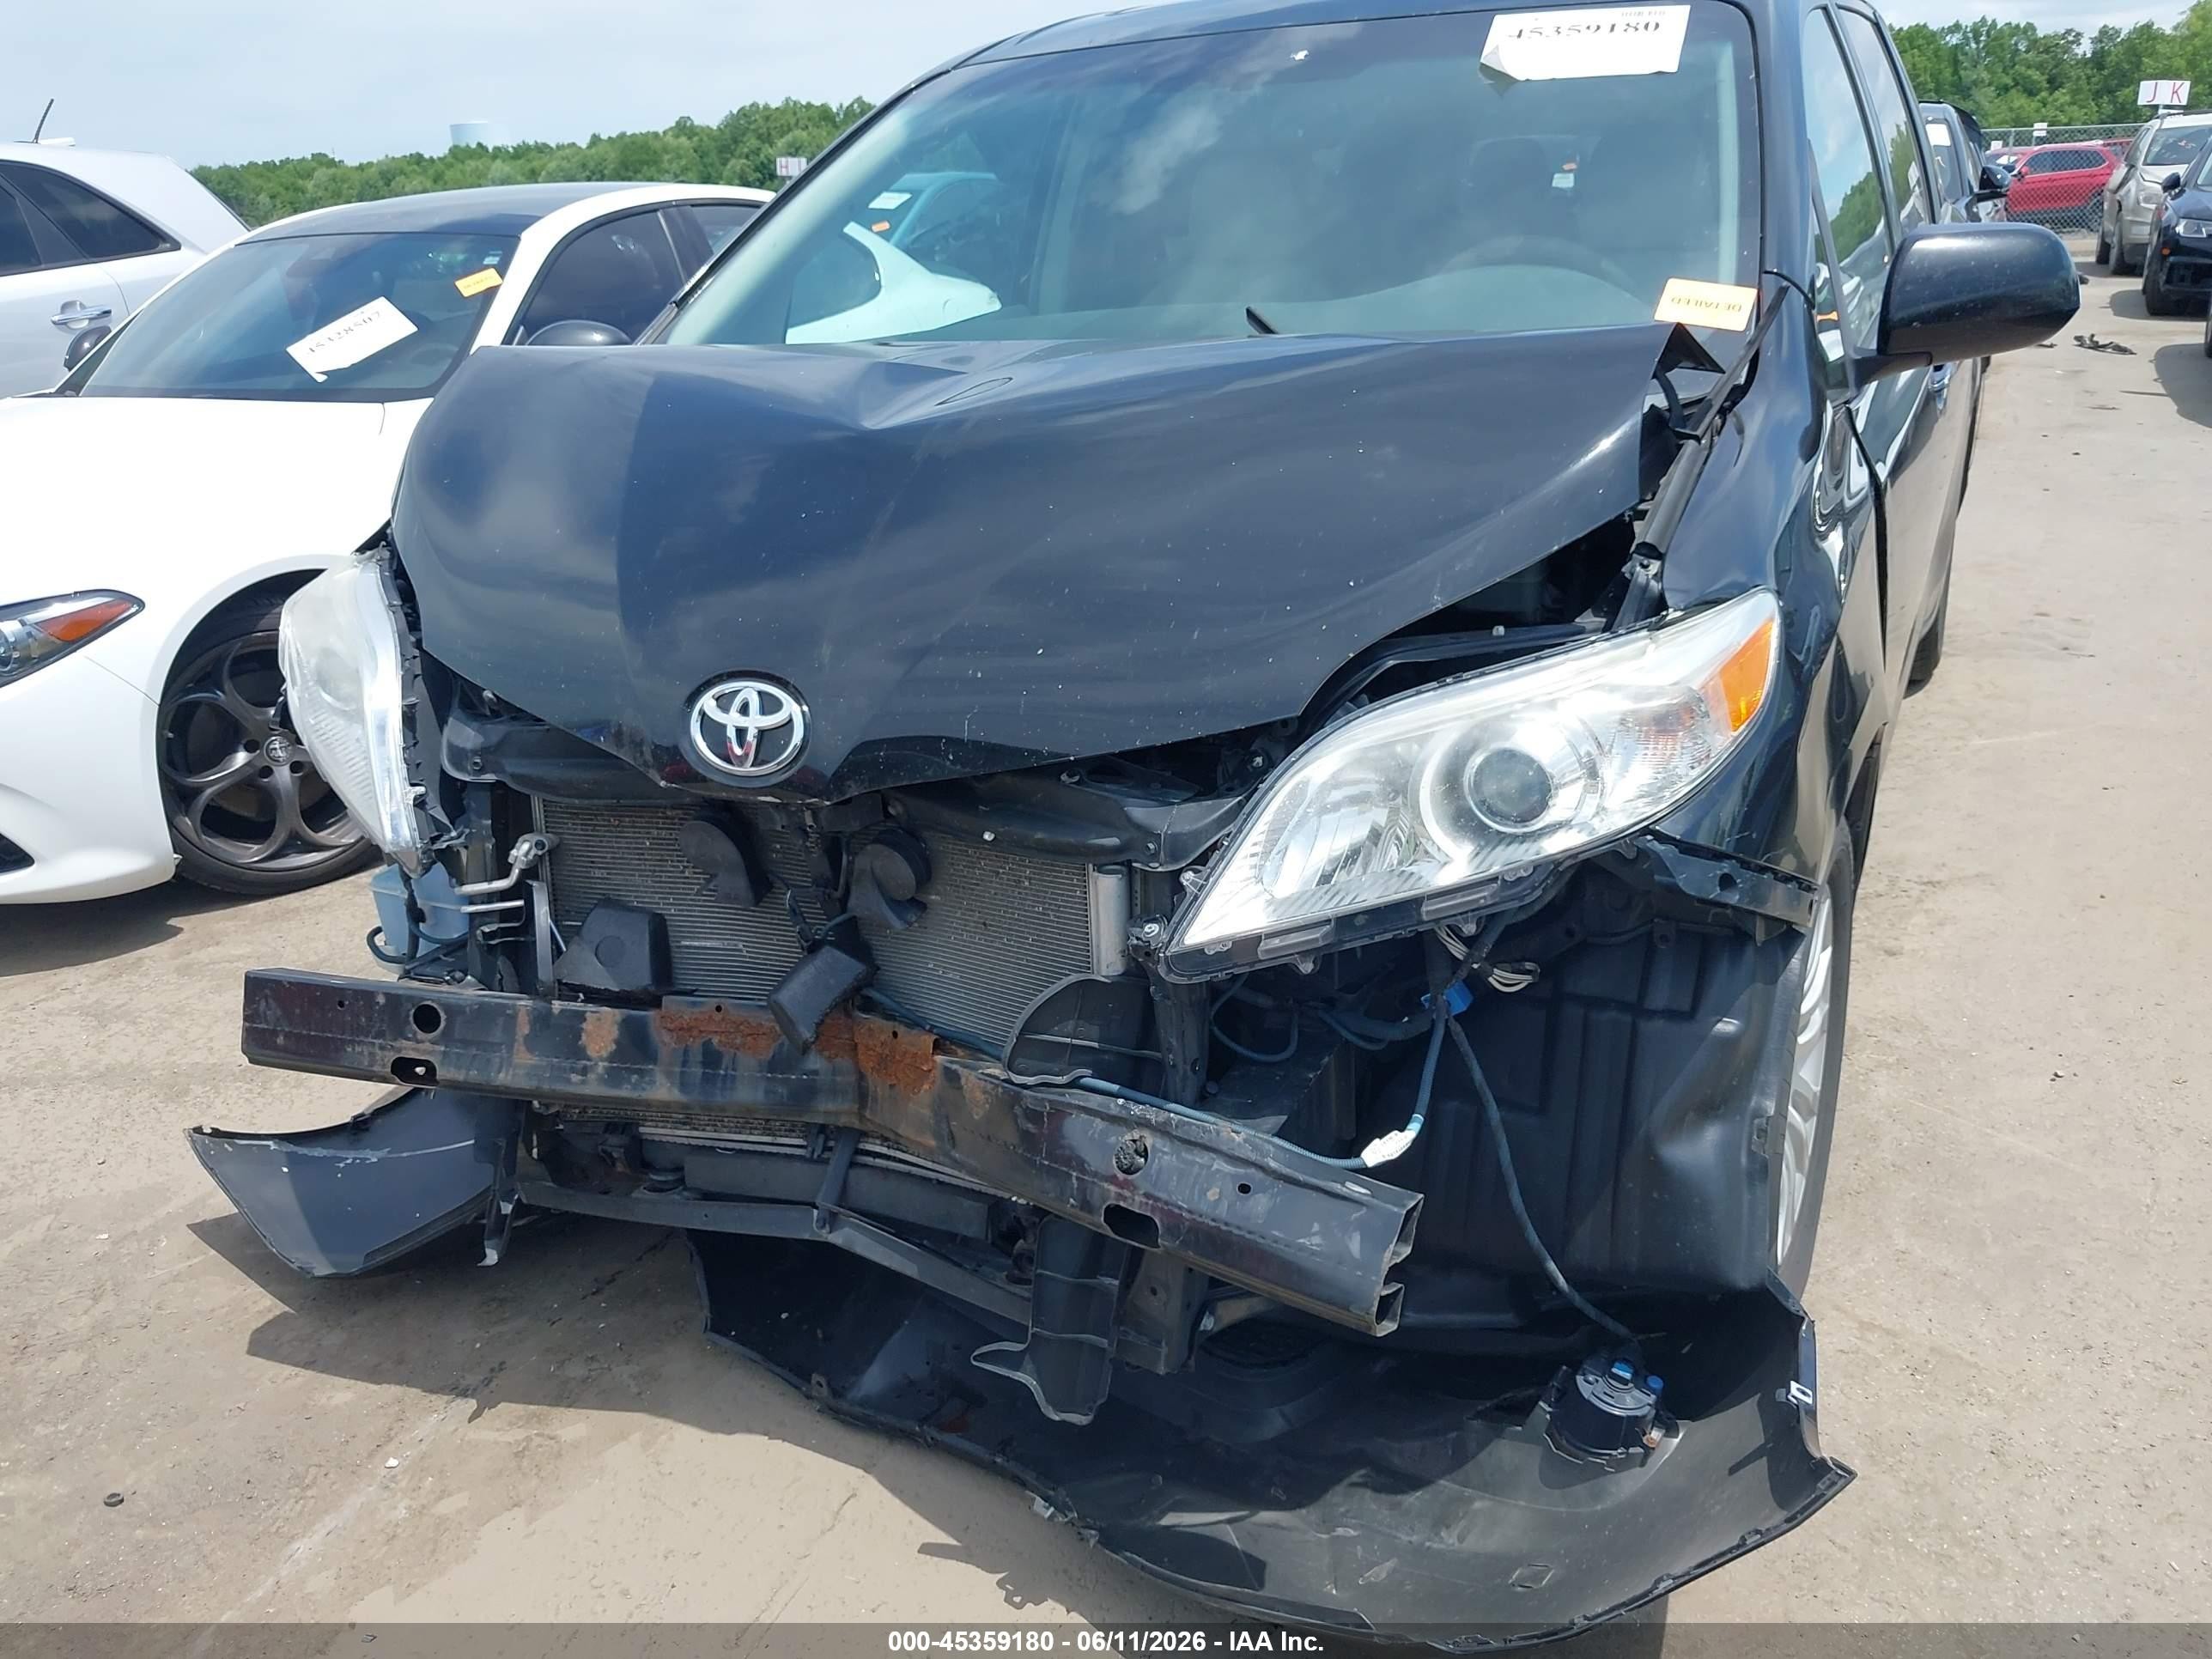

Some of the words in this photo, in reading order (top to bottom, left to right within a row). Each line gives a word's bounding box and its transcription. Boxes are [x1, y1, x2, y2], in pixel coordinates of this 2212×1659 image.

[1508, 21, 1661, 40] 45359180
[2145, 82, 2159, 103] J
[2170, 82, 2185, 103] K
